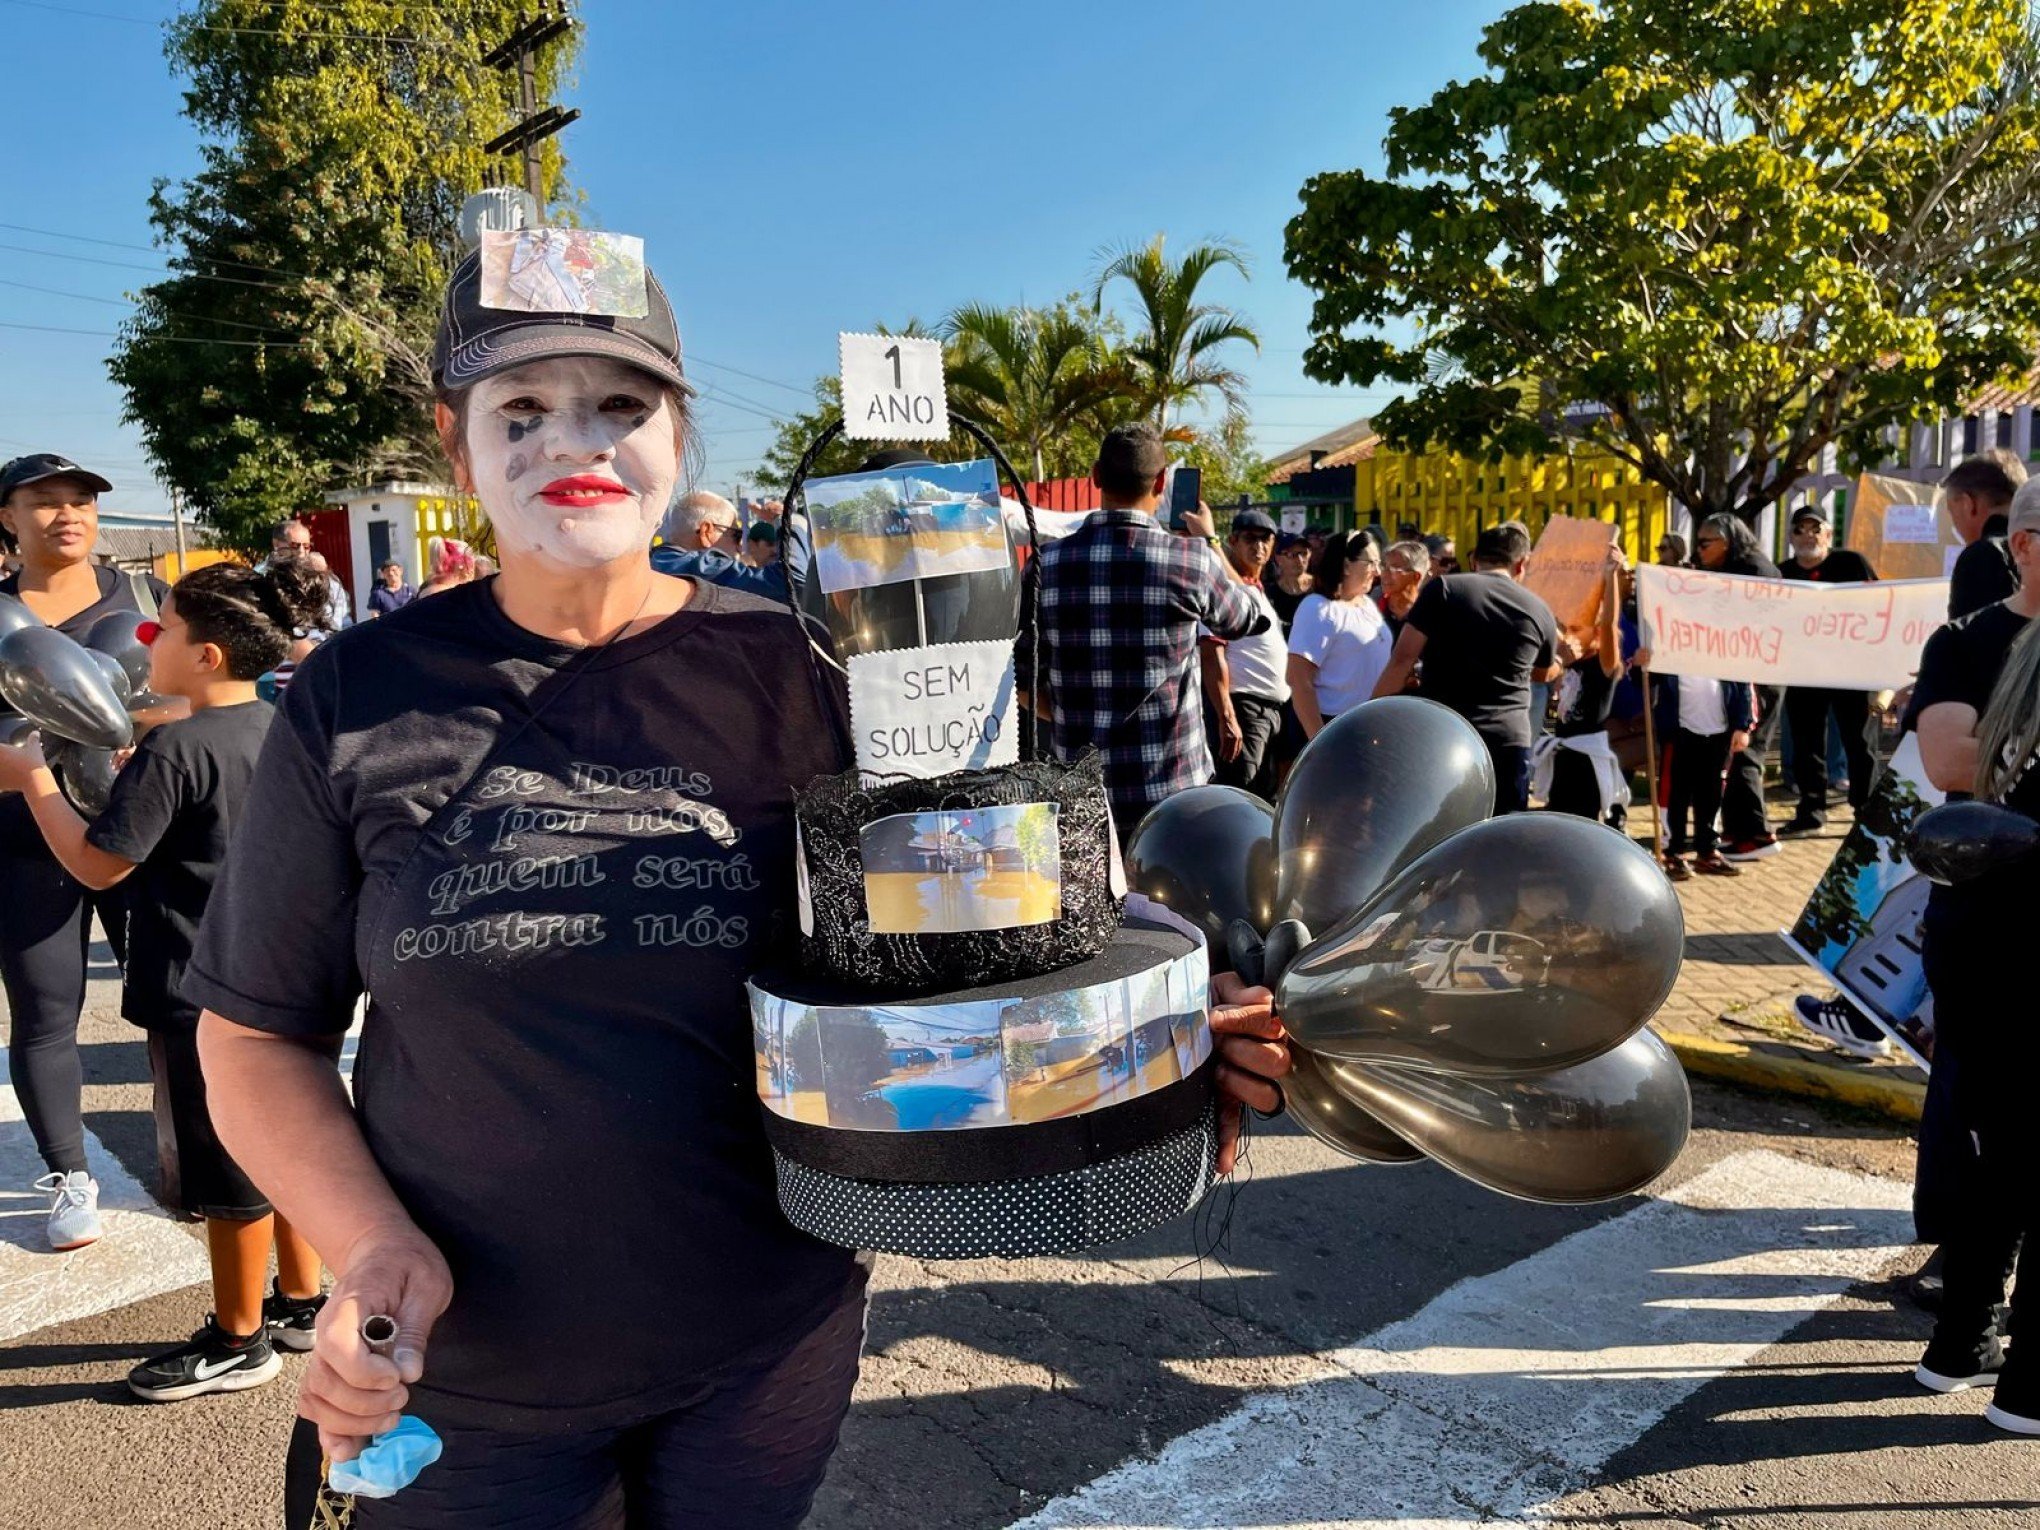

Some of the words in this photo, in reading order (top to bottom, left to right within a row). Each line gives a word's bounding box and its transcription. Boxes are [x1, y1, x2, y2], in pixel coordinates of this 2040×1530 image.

[884, 344, 902, 390] 1
[866, 393, 935, 425] ANO
[903, 662, 970, 700] SEM
[870, 703, 1001, 759] SOLUÇÃO
[478, 765, 545, 799] Se
[567, 761, 713, 796] Deus
[443, 808, 474, 846] é
[490, 802, 600, 852] por
[428, 852, 607, 916] quem
[632, 853, 761, 891] será
[394, 910, 607, 961] contra
[633, 905, 749, 948] nós
